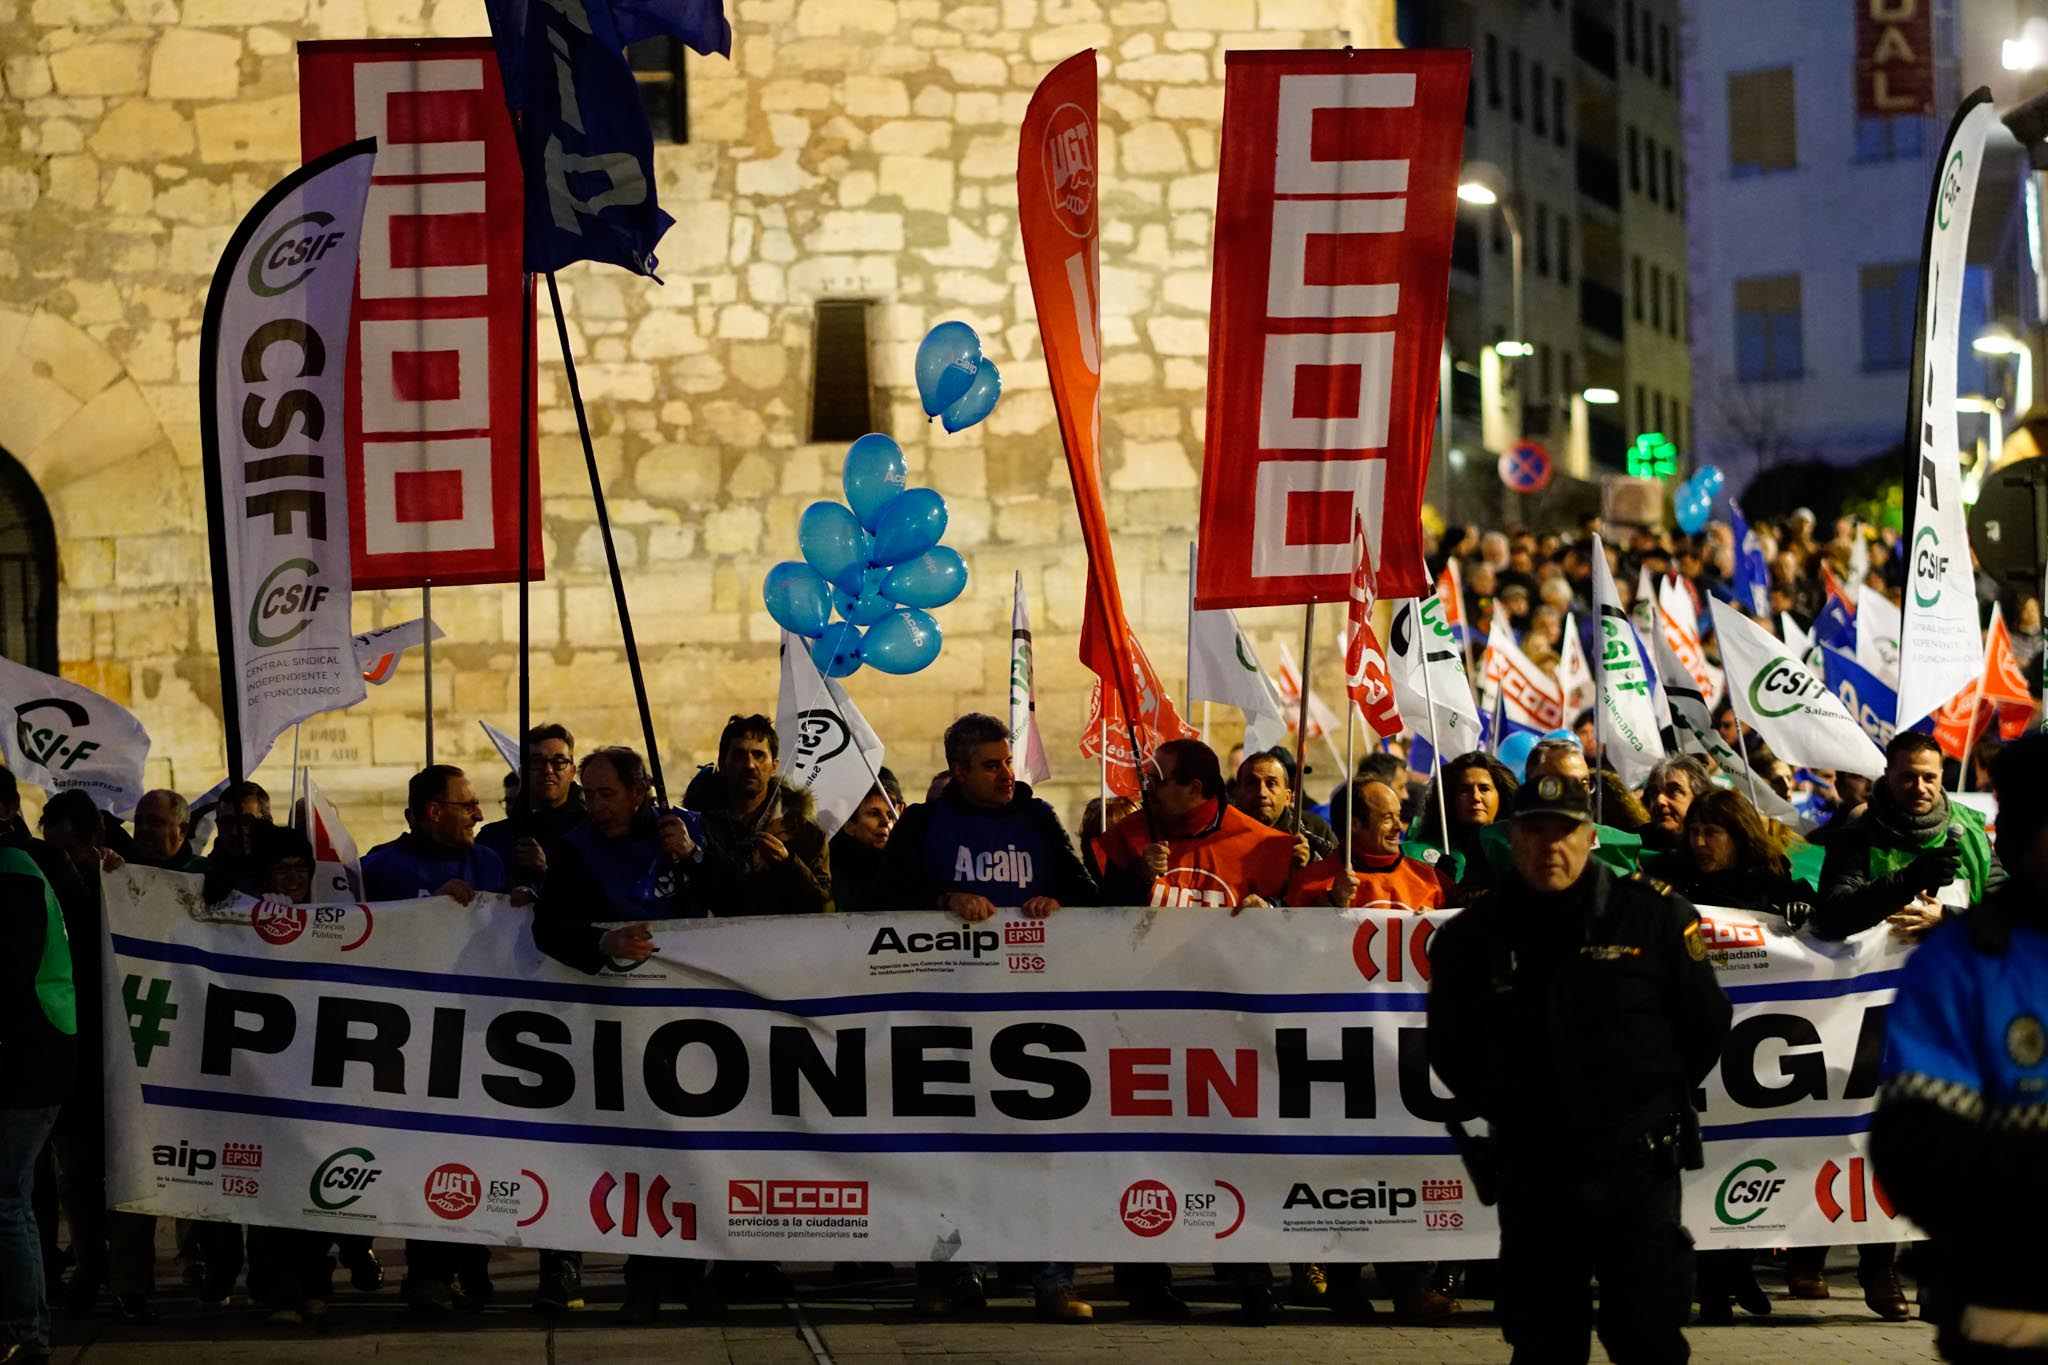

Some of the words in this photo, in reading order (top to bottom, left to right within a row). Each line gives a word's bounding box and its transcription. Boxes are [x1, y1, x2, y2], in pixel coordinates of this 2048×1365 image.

[267, 231, 346, 270] CSIF
[353, 58, 494, 555] CCOO
[1251, 72, 1416, 578] CCOO
[241, 317, 327, 541] CSIF
[1917, 549, 1949, 583] CSIF
[262, 584, 330, 619] CSIF
[246, 659, 289, 678] CENTRAL
[292, 656, 340, 666] SINDICAL
[246, 671, 328, 692] INDEPENDIENTE
[334, 671, 341, 680] Y
[248, 695, 259, 707] DE
[264, 686, 341, 700] FUNCIONARIOS
[953, 844, 1034, 888] Acaip
[312, 921, 345, 931] Servicios
[1008, 929, 1041, 942] EPSU
[1700, 922, 1759, 944] COO
[868, 924, 999, 958] Acaip
[1008, 956, 1045, 970] USO
[152, 1139, 217, 1176] aip
[225, 1151, 259, 1165] EPSU
[323, 1165, 382, 1191] CSIF
[432, 1170, 475, 1195] UGT
[489, 1180, 521, 1197] ESP
[486, 1194, 520, 1206] Servicios
[773, 1186, 862, 1209] CCOO
[1127, 1189, 1170, 1212] UGT
[1185, 1194, 1216, 1210] ESP
[1282, 1181, 1416, 1216] Acaip
[1425, 1187, 1459, 1200] EPSU
[1727, 1178, 1786, 1204] CSIF
[486, 1204, 518, 1215] Públicos
[589, 1170, 697, 1241] CIG
[1183, 1209, 1217, 1217] Servicios
[728, 1217, 779, 1227] servicios
[782, 1219, 789, 1227] a
[792, 1217, 802, 1227] la
[806, 1217, 868, 1227] ciudadanía
[1183, 1218, 1216, 1227] Públicos
[1426, 1213, 1464, 1228] USO
[728, 1229, 785, 1238] instituciones
[787, 1230, 850, 1240] penitenciarias
